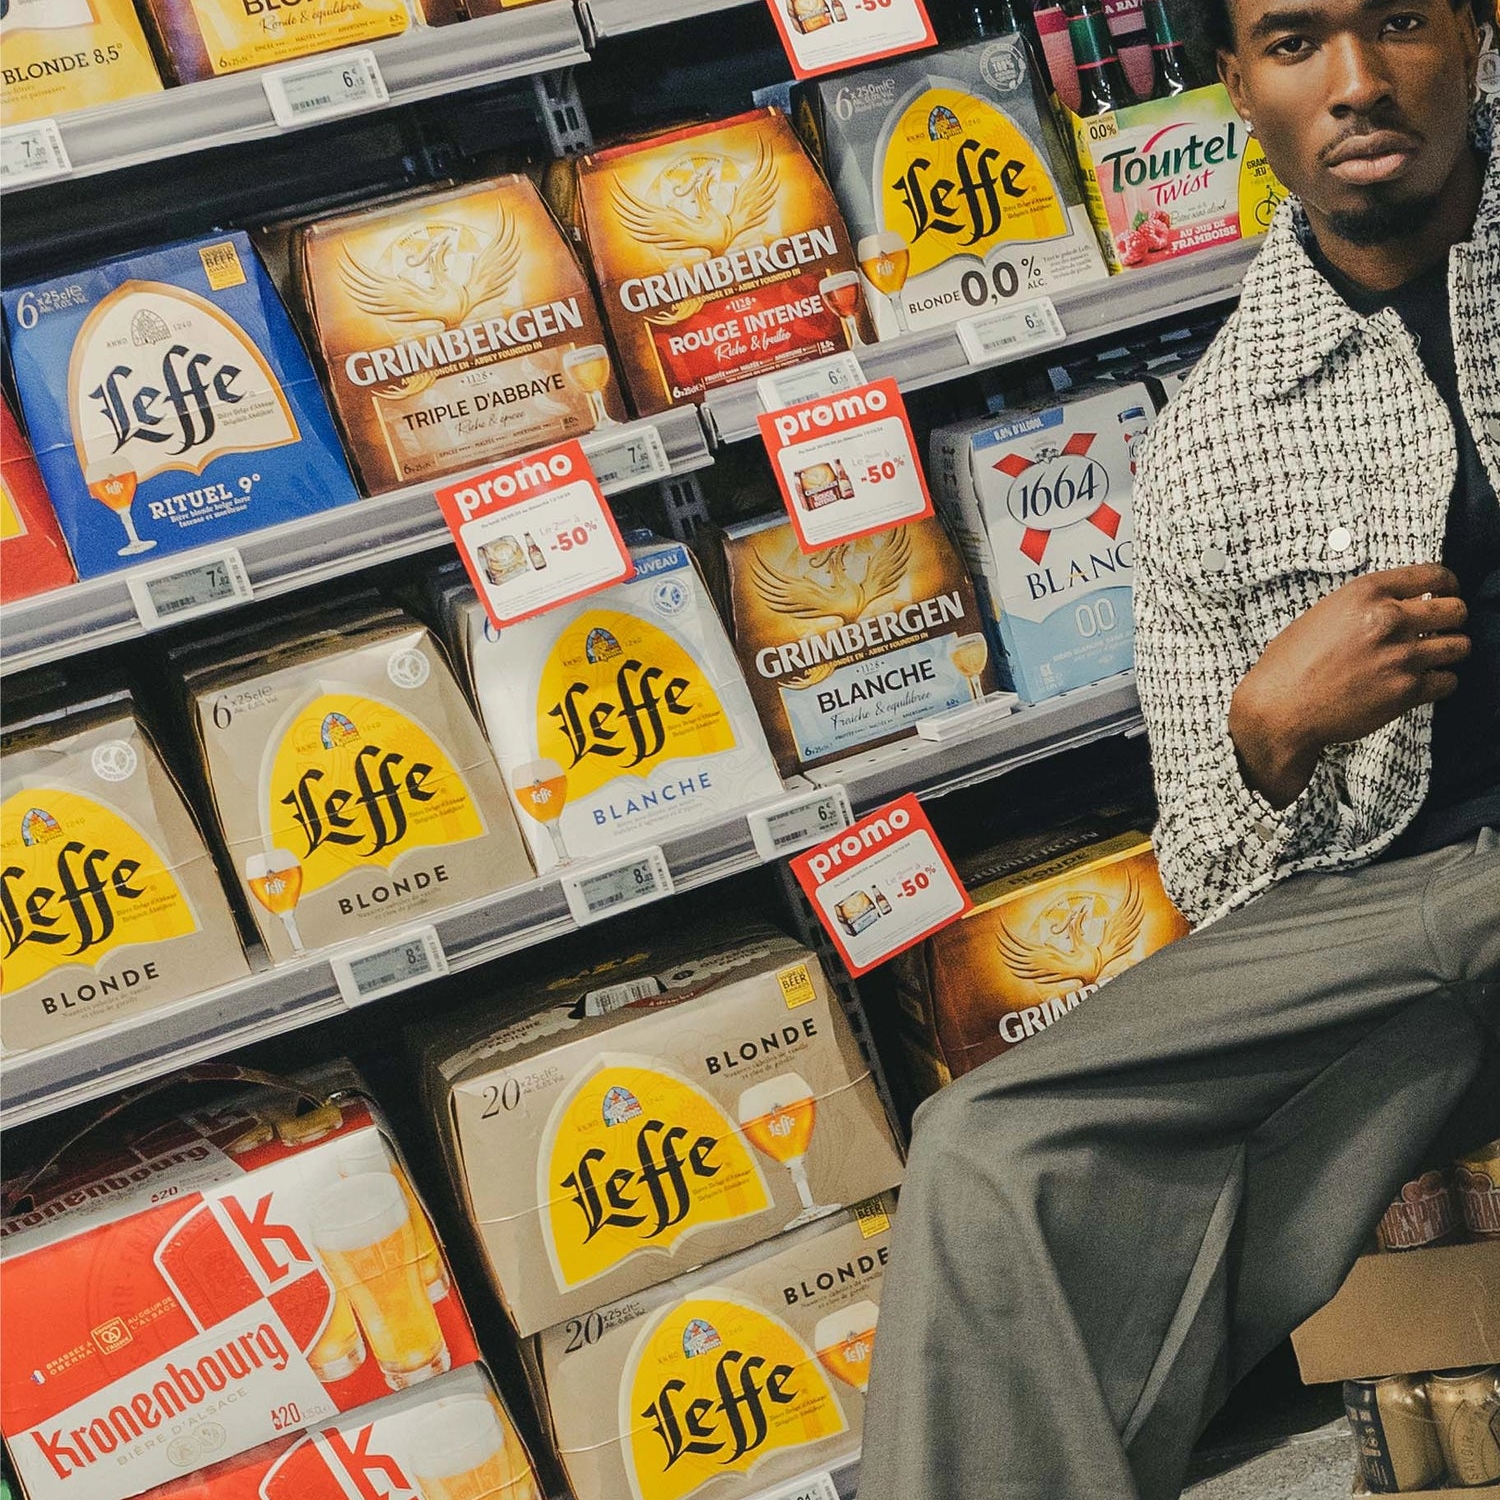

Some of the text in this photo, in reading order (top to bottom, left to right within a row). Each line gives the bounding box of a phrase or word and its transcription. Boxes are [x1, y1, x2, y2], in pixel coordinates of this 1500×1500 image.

[2, 52, 89, 84] BLONDE
[1102, 122, 1238, 193] Tourtel
[892, 139, 1027, 246] Leffe
[1148, 169, 1214, 207] Twist
[1172, 226, 1237, 250] FRAMBOISE
[619, 226, 839, 313] GRIMBERGEN
[668, 294, 824, 355] ROUGE INTENSE
[909, 290, 960, 314] BLONDE
[344, 297, 583, 387] GRIMBERGEN
[88, 345, 246, 456] Leffe
[403, 373, 566, 432] TRIPLE D'ABBAYE
[775, 389, 887, 446] promo
[453, 453, 572, 520] promo
[861, 455, 906, 484] -50%
[1020, 464, 1099, 520] 1664
[148, 484, 233, 520] RITUEL
[550, 520, 598, 553] -50%
[1027, 540, 1133, 600] BLANC
[756, 590, 964, 679] GRIMBERGEN
[547, 659, 695, 769] Leffe
[818, 659, 936, 714] BLANCHE
[280, 745, 439, 859] Leffe
[592, 772, 713, 825] BLANCHE
[807, 809, 909, 883] promo
[0, 841, 147, 959] Leffe
[337, 865, 449, 915] BLONDE
[897, 865, 936, 899] -50%
[41, 962, 160, 1015] BLONDE
[783, 973, 807, 986] BEER
[706, 1019, 817, 1075] BLONDE
[481, 1079, 520, 1119] 20
[560, 1119, 723, 1244] Leffe
[783, 1247, 888, 1305] BLONDE
[565, 1313, 603, 1354] 20
[31, 1322, 289, 1480] Kronenbourg
[117, 1386, 248, 1466] BIÈRE D'ALSACE
[279, 1403, 301, 1426] 20
[641, 1351, 799, 1472] Leffe
